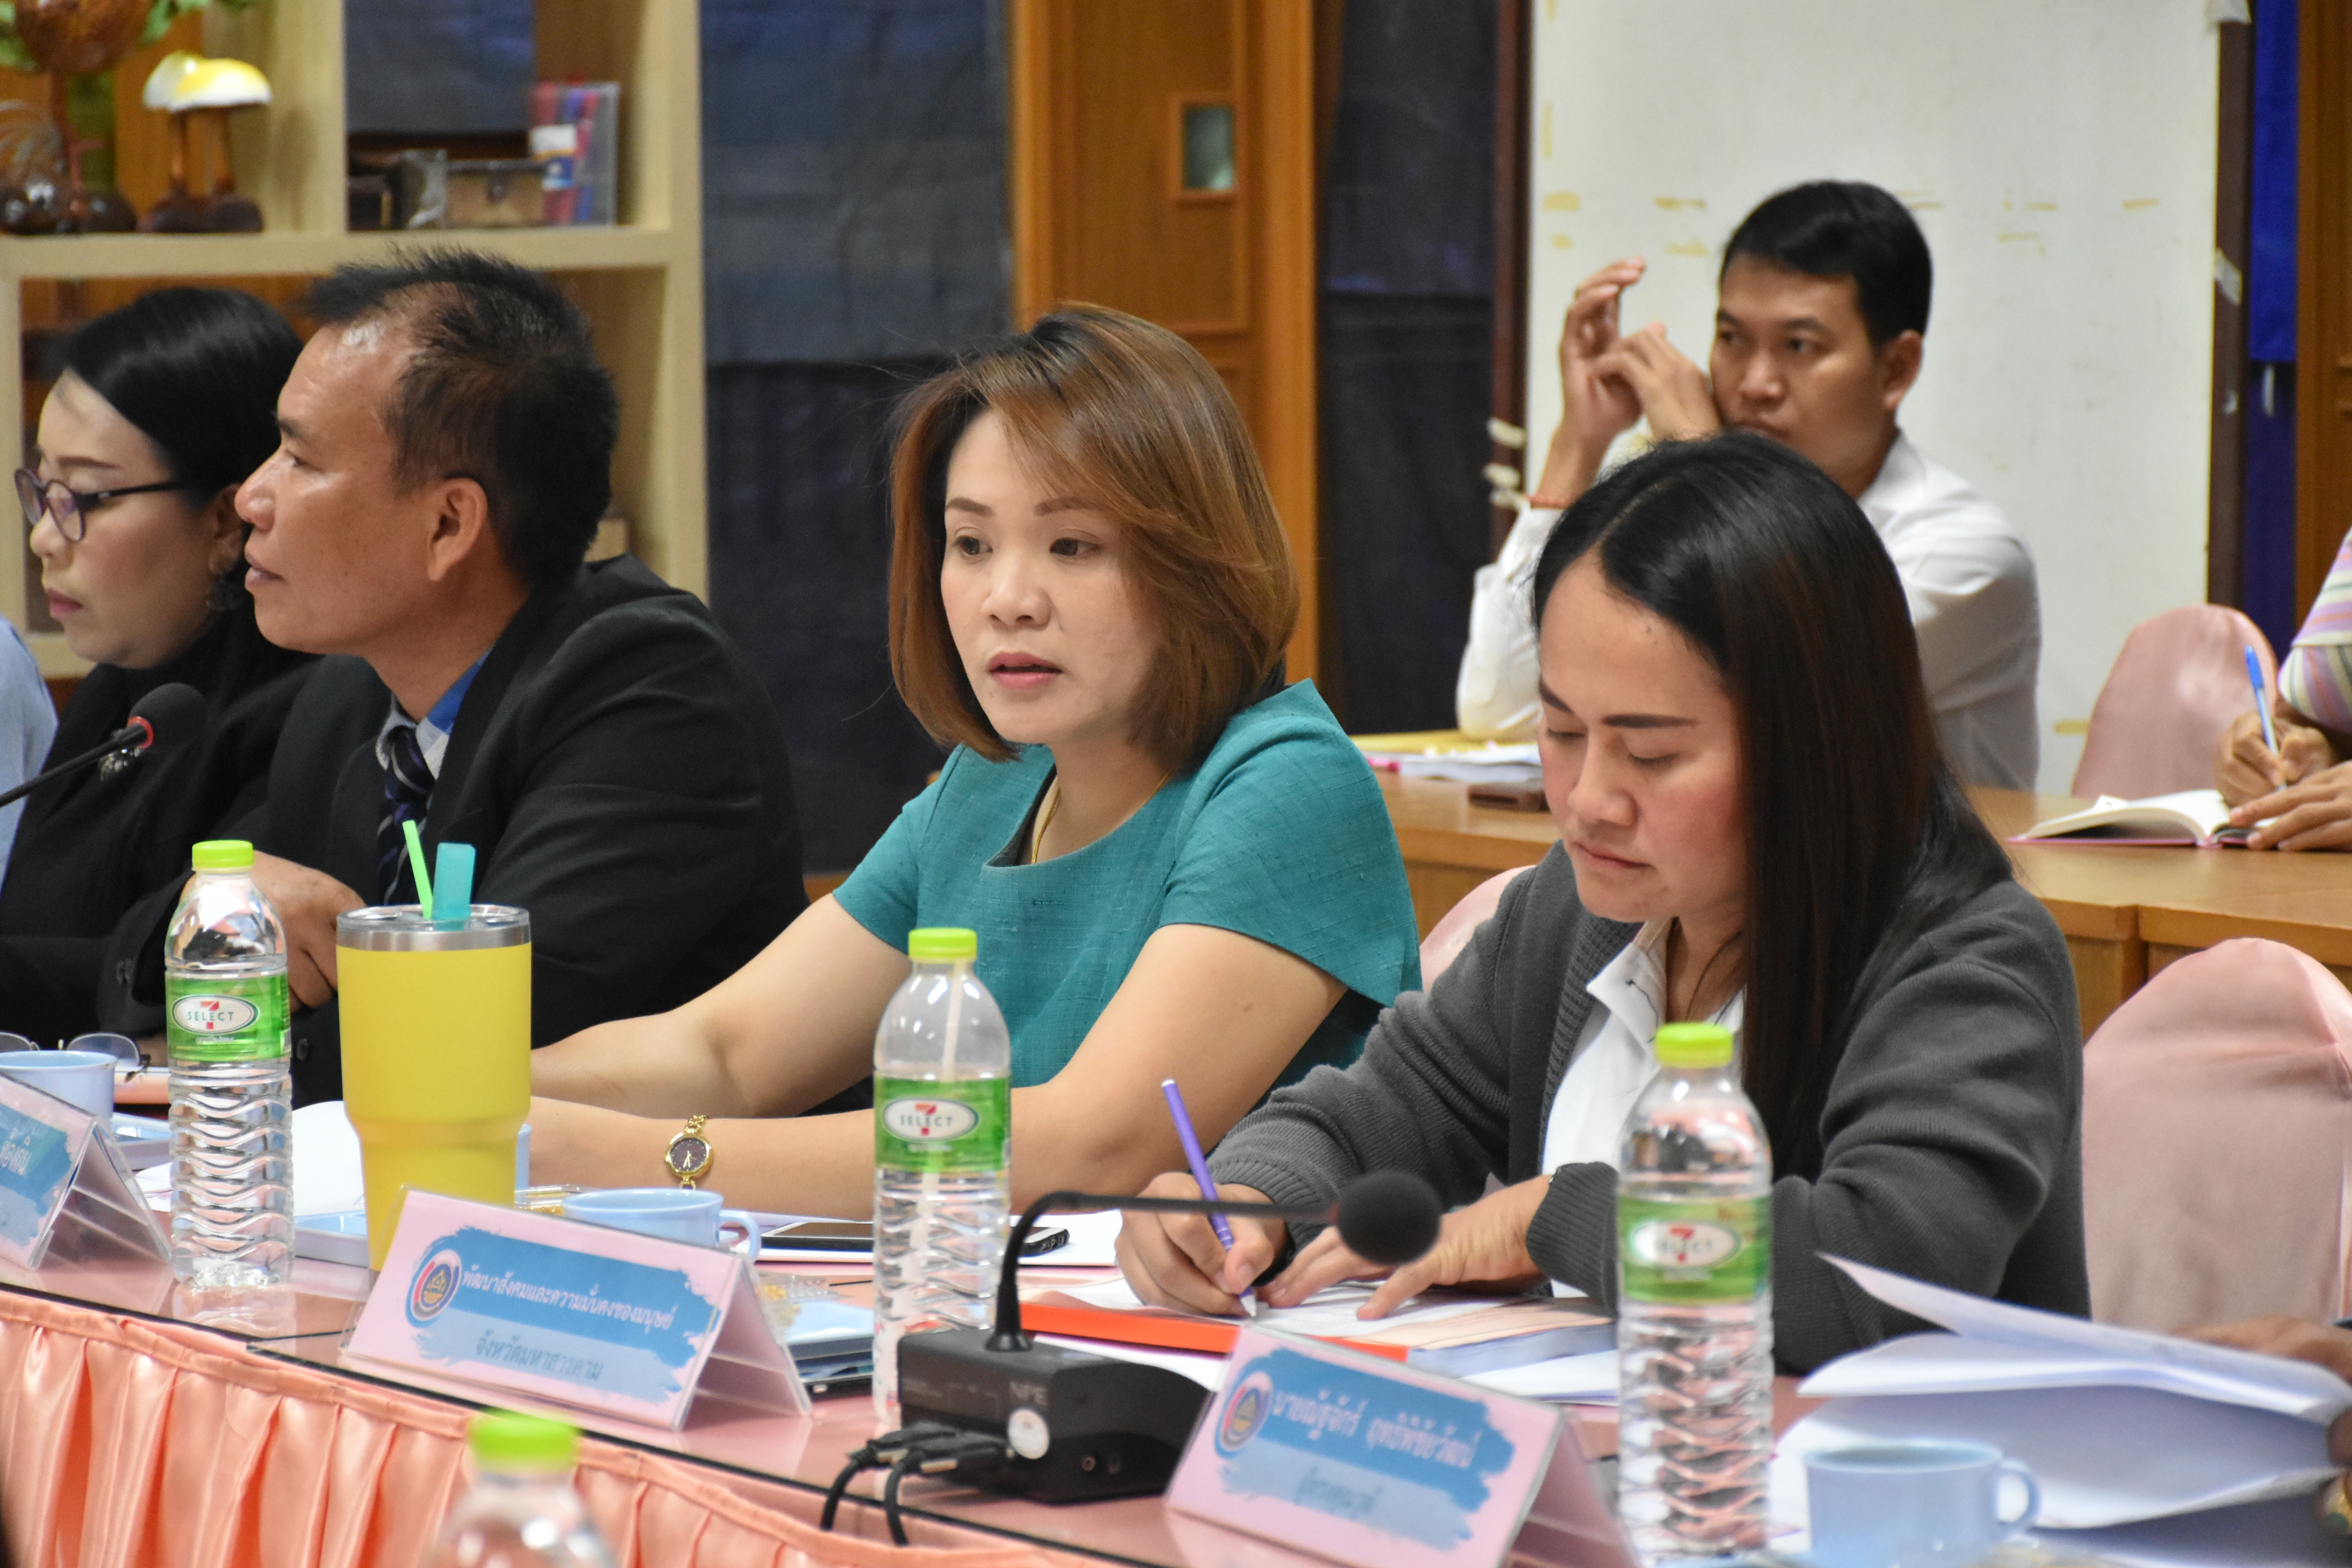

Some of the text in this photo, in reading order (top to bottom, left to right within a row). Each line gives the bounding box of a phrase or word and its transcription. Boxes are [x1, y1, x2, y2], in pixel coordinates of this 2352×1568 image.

[188, 1011, 234, 1022] SELECT
[900, 1115, 953, 1127] SELECT
[462, 1265, 679, 1334] พัฒนาสังคมและความมั่นคงของมนุษย์
